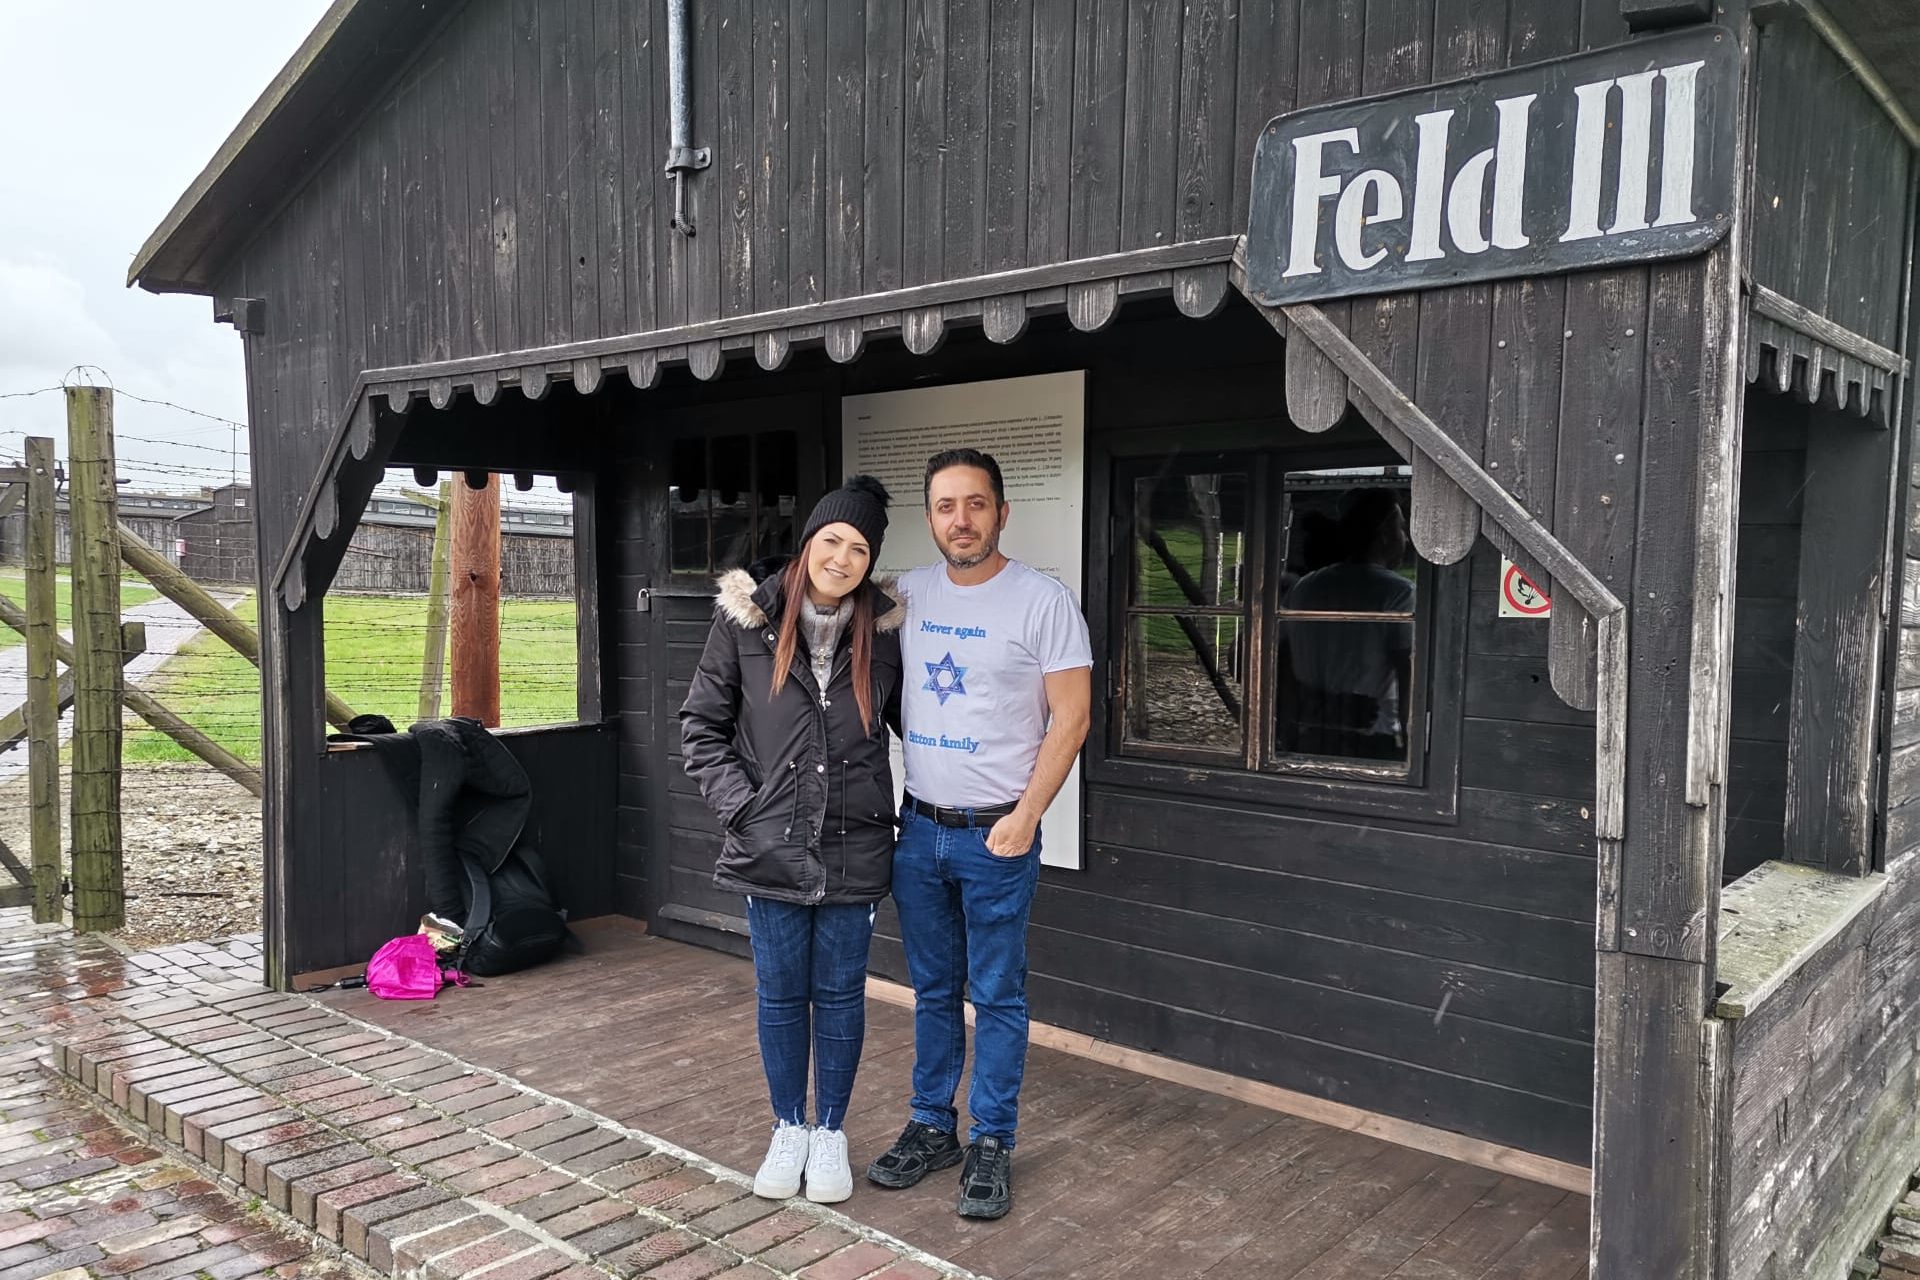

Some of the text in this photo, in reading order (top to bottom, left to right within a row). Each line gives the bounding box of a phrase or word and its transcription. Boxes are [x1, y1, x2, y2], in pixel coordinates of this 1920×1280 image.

[1282, 59, 1705, 278] Feld III
[920, 620, 986, 640] Never again
[940, 734, 980, 753] family
